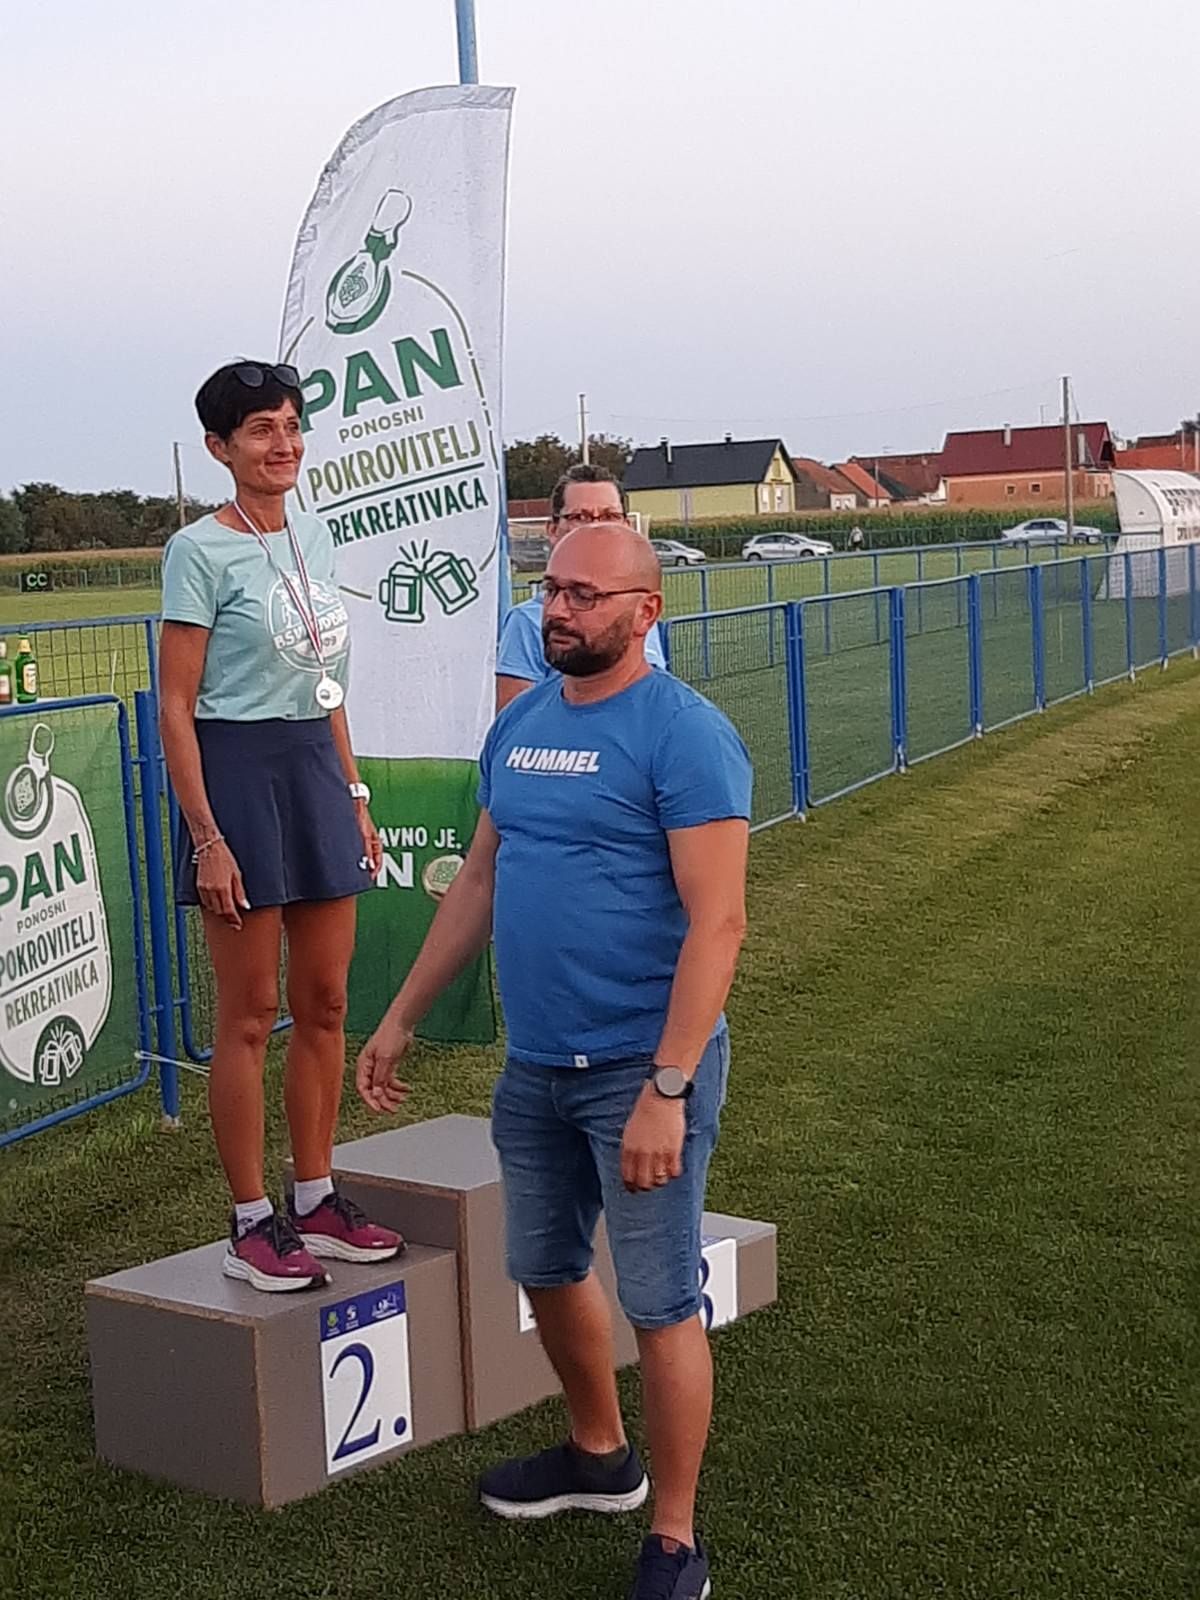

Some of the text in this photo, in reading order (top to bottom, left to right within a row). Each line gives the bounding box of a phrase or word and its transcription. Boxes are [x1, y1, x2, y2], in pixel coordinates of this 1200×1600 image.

[300, 328, 463, 434] PAN
[339, 406, 425, 443] PONOSNI
[307, 420, 482, 502] POKROVITELJ
[327, 478, 489, 548] REKREATIVACA
[505, 746, 600, 773] HUMMEL
[378, 826, 462, 849] AVNO JE.
[17, 899, 67, 934] PONOSNI
[5, 959, 99, 1031] REKREATIVACA
[329, 1342, 407, 1462] 2.
